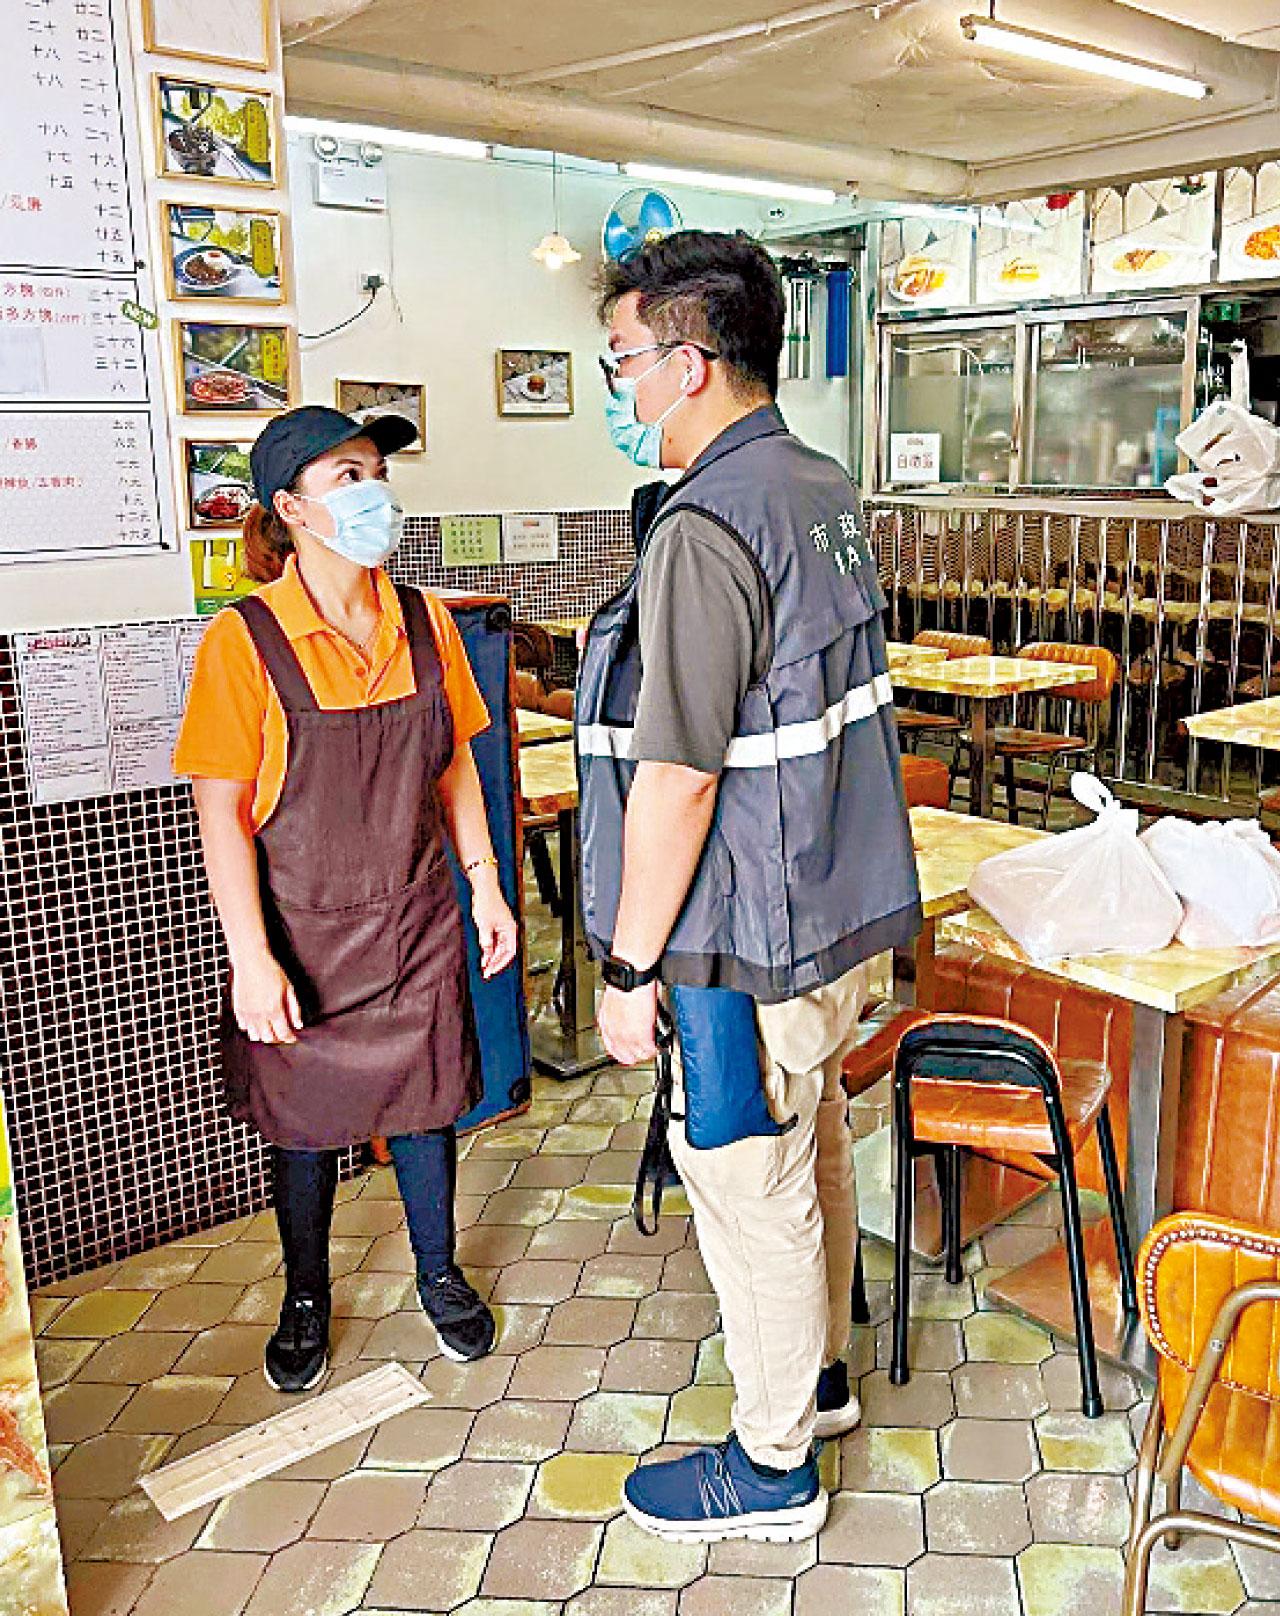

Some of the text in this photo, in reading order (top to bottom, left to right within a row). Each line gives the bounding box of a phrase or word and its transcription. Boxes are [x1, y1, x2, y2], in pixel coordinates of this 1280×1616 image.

[28, 20, 56, 34] 二十
[32, 44, 60, 60] 十八
[78, 51, 105, 63] 二十
[33, 71, 63, 88] 十八
[81, 79, 108, 93] 二十
[83, 104, 110, 118] 二十
[38, 122, 68, 137] 十八
[44, 151, 72, 163] 十七
[47, 174, 73, 188] 十五
[91, 177, 119, 193] 十七
[95, 203, 123, 218] 十二
[97, 250, 125, 264] 十五
[96, 356, 138, 370] 三十二
